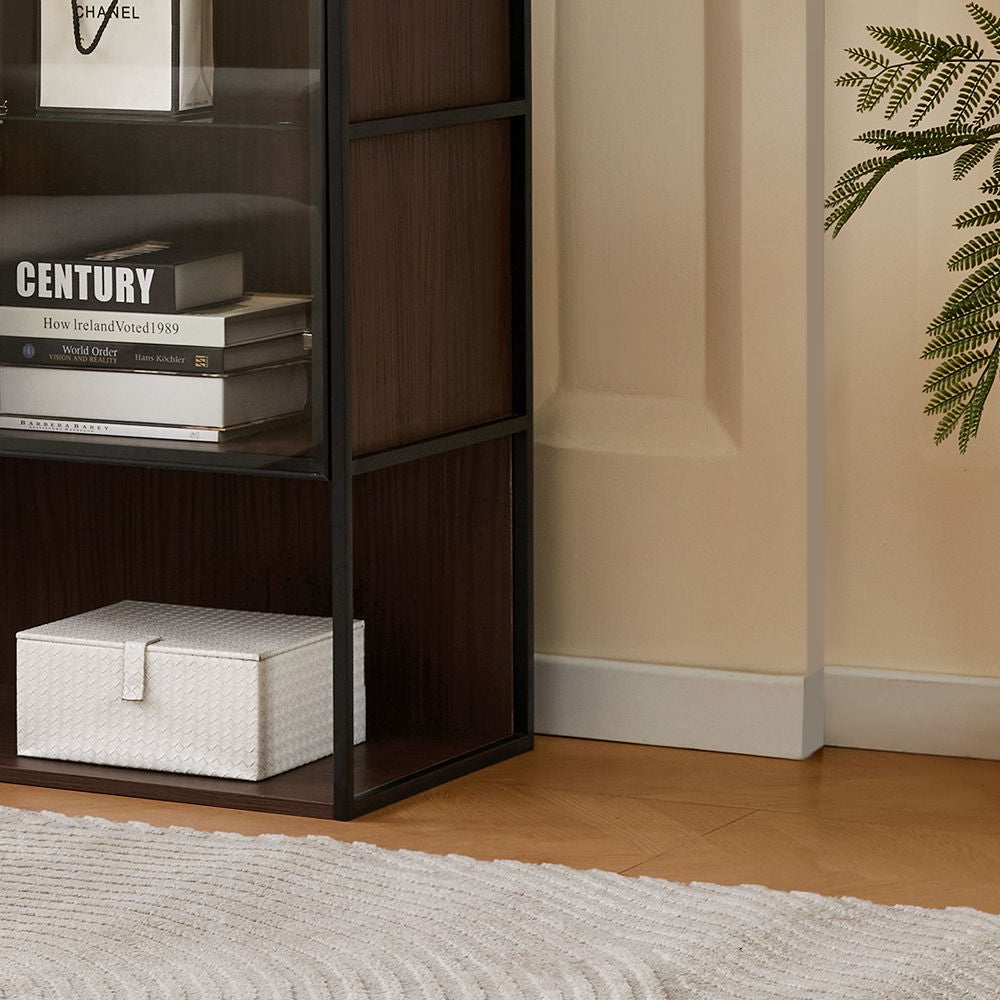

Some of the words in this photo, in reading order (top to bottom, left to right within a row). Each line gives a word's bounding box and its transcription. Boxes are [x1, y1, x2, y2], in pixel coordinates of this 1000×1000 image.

[16, 260, 155, 305] CENTURY
[43, 317, 71, 330] How
[62, 345, 89, 355] World
[91, 346, 118, 357] Order
[135, 353, 155, 361] Hans
[48, 353, 72, 361] VISION
[89, 356, 118, 364] REALITY
